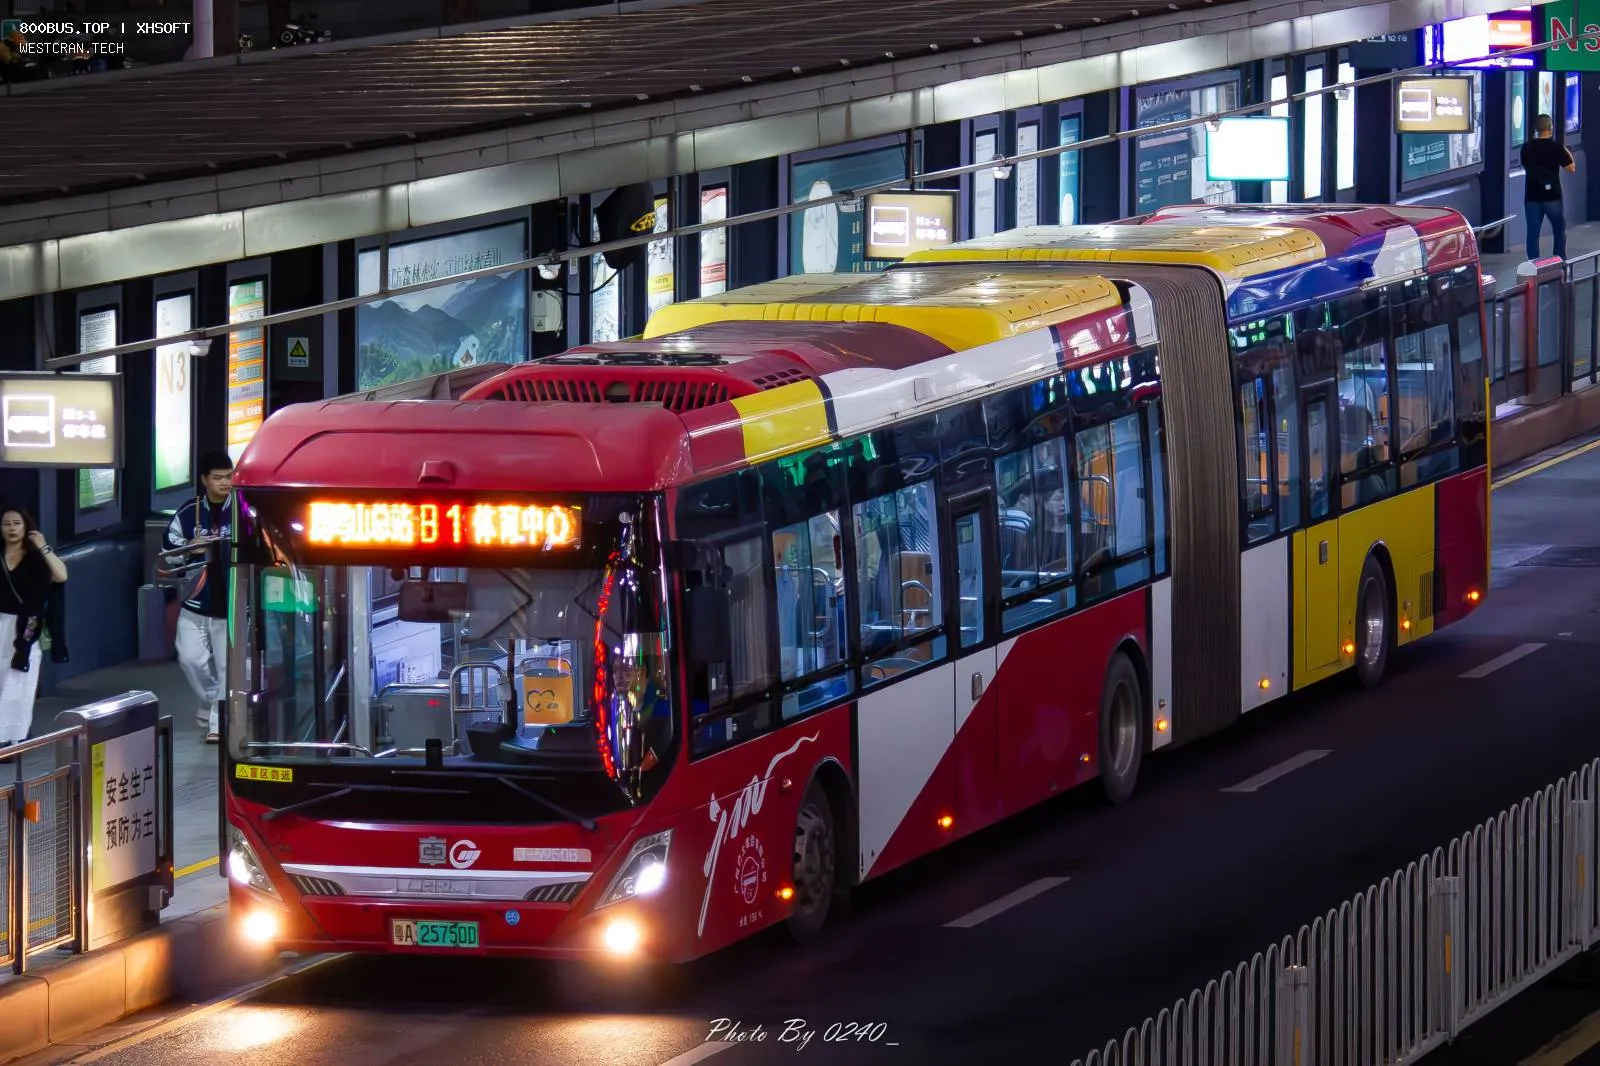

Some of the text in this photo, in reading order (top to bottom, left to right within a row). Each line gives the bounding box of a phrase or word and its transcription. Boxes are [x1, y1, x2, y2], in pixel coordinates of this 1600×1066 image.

[159, 351, 187, 395] N3
[106, 765, 153, 807] 安全生产
[249, 766, 291, 781] 盲区勿近
[105, 808, 153, 851] 预防为主
